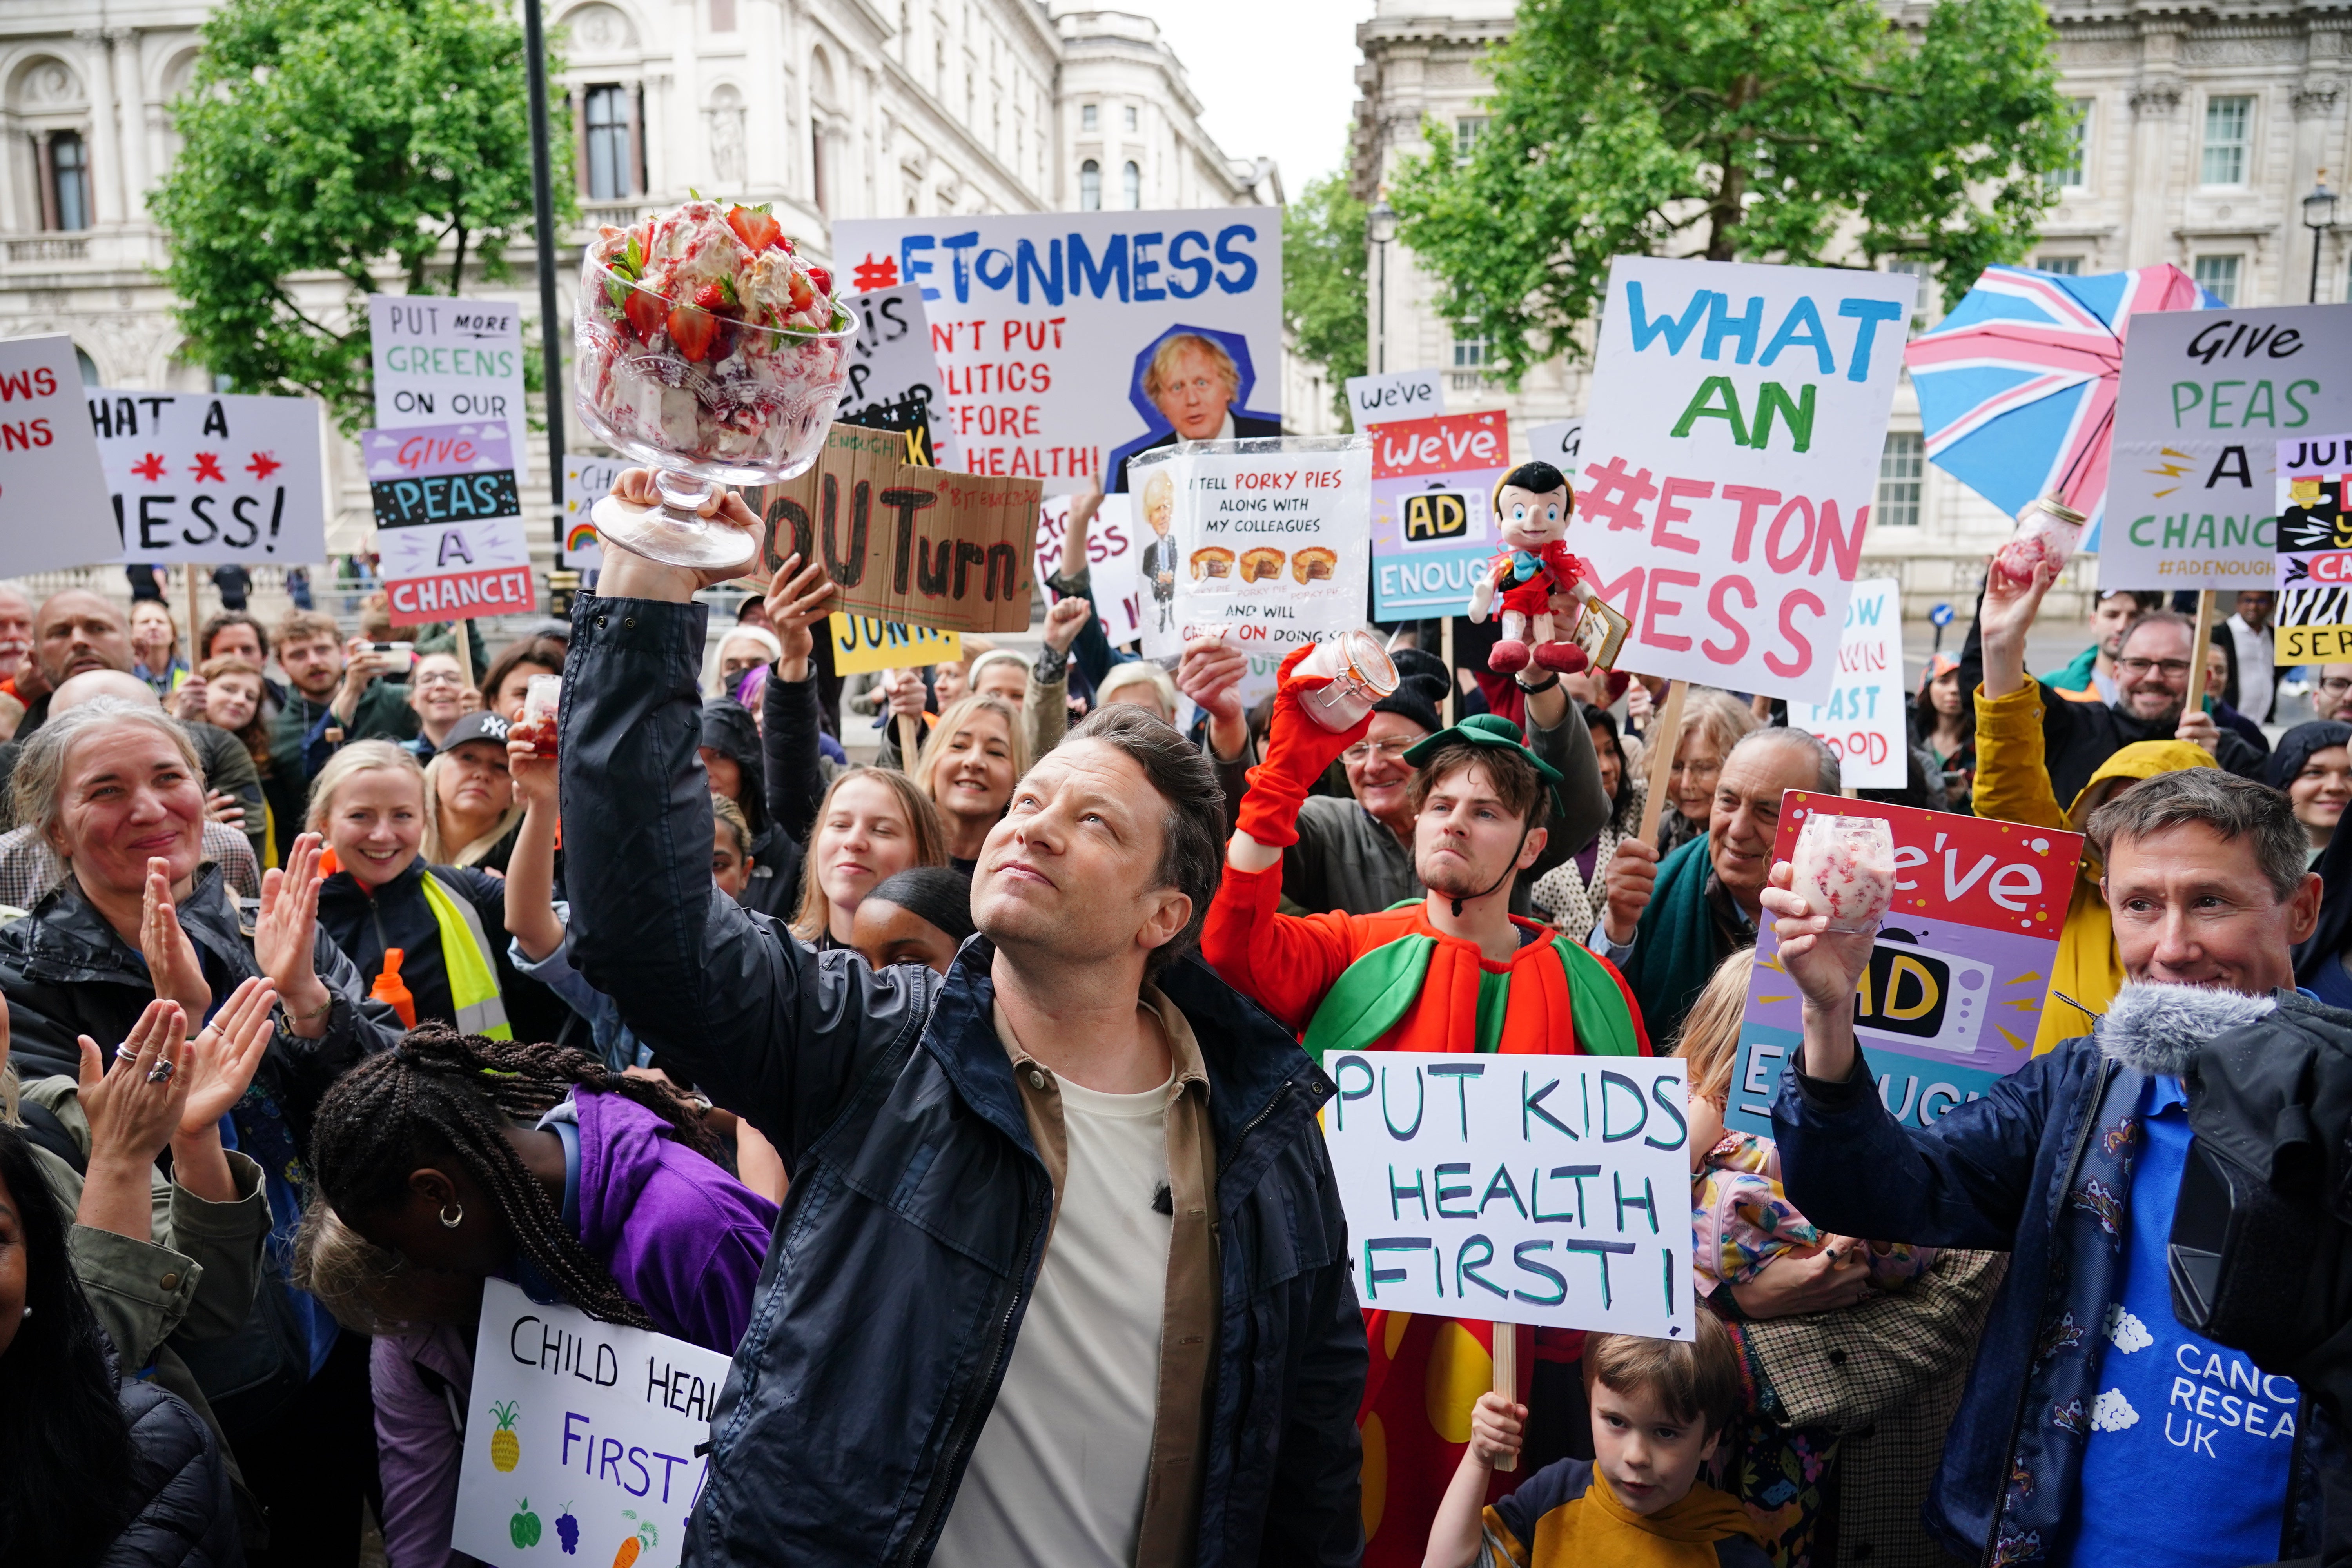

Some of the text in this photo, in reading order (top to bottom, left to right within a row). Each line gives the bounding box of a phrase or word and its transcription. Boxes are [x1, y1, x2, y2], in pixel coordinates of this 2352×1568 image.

[391, 306, 510, 335] PUT MORE
[931, 317, 1066, 353] N'T PUT
[1626, 281, 1902, 382] WHAT
[387, 346, 513, 378] GREENS
[939, 362, 1051, 395] LITICS
[88, 397, 229, 439] HAT A
[394, 391, 506, 417] ON OUR
[949, 405, 1040, 438] FORE
[1670, 376, 1817, 454] AN
[2171, 379, 2320, 429] PEAS
[968, 446, 1098, 478] HEALTH!
[1189, 469, 1342, 490] I TELL PORKY PIES
[2205, 446, 2252, 489] A
[394, 475, 499, 521] PEAS
[1220, 498, 1309, 512] ALONG WITH
[1407, 494, 1465, 539] AD
[1574, 456, 1870, 581] #ETON
[1206, 518, 1320, 533] MY COLLEAGUES
[437, 528, 473, 567] A
[2158, 560, 2276, 576] #ADENOUGH
[393, 573, 527, 614] CHANCE!
[1225, 605, 1295, 618] AND WILL
[1240, 624, 1267, 641] ON
[1274, 629, 1323, 643] DOING
[1577, 556, 1826, 679] MESS
[1839, 641, 1886, 672] WN
[1813, 732, 1887, 765] OOD
[1894, 832, 2042, 912] e've
[1336, 1055, 1687, 1151] PUT KIDS
[1389, 1162, 1659, 1235] HEALTH
[1365, 1233, 1681, 1337] FIRST!
[510, 1315, 715, 1423] CHILD HEAL
[2176, 1343, 2296, 1405] CANC
[2170, 1377, 2295, 1439] RESEA
[2164, 1412, 2220, 1459] UK
